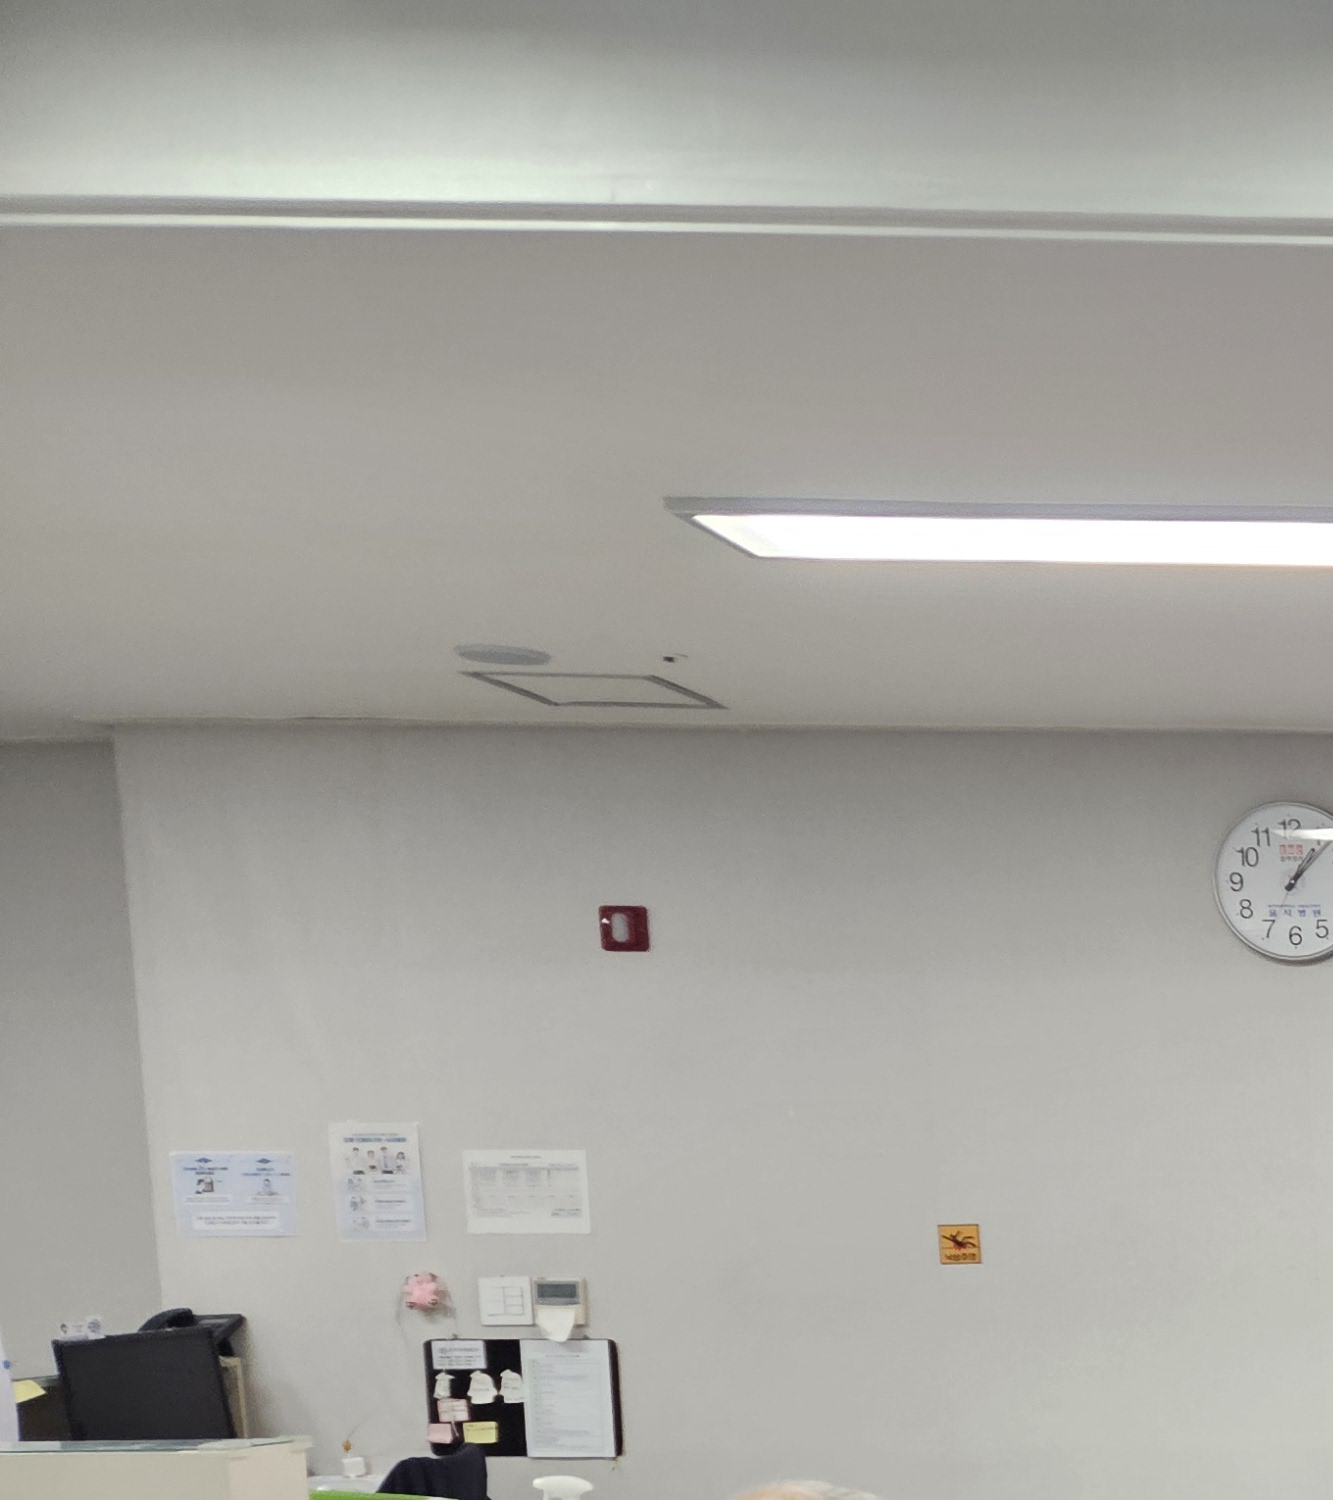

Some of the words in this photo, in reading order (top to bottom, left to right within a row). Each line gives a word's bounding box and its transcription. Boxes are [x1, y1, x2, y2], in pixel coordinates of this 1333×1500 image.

[1251, 827, 1271, 847] 11
[1235, 847, 1259, 867] 10
[1229, 872, 1244, 892] 9
[1239, 899, 1253, 919] 8
[1262, 919, 1276, 938] 7
[1289, 925, 1303, 945] 6
[1315, 919, 1329, 939] 5
